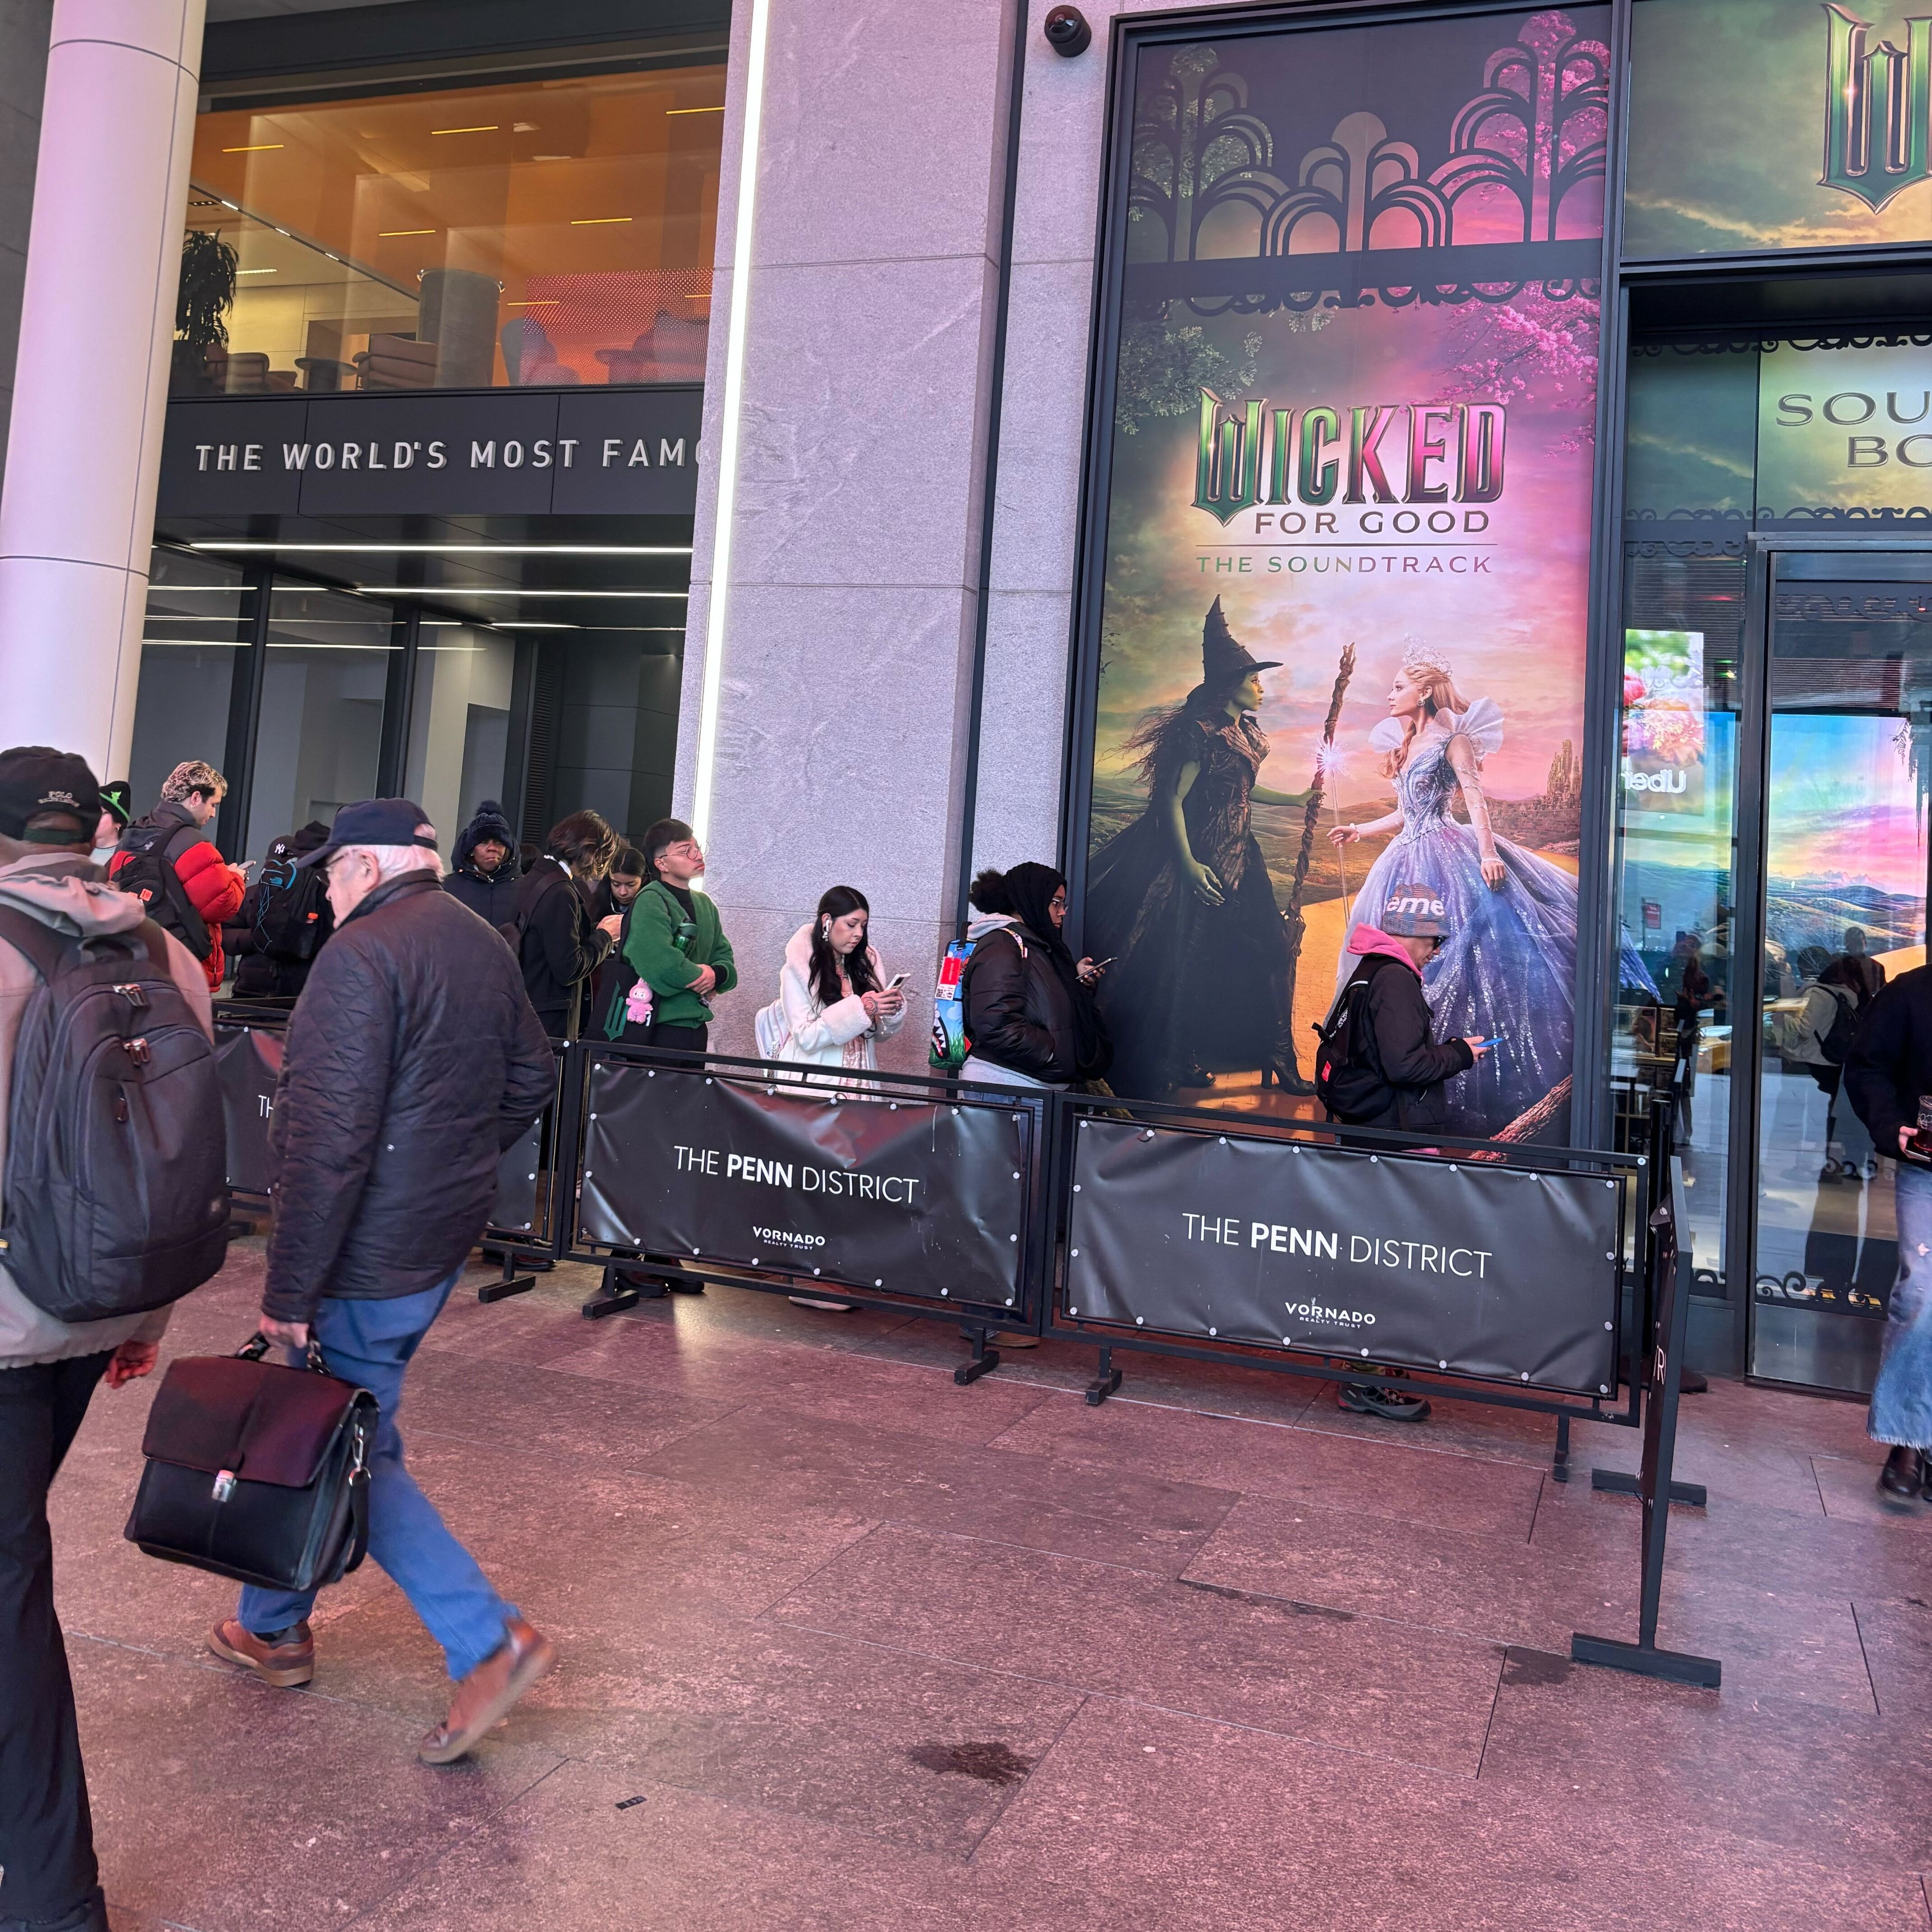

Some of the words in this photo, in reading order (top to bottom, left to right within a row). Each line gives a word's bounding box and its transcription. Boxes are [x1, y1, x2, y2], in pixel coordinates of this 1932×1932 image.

[195, 445, 263, 471] THE
[283, 441, 447, 470] WORLD'S
[470, 440, 580, 468] MOST
[1191, 386, 1507, 527] WICKED
[1255, 512, 1339, 534] FOR
[1359, 511, 1489, 534] GOOD
[1196, 557, 1252, 573] THE
[1267, 556, 1493, 573] SOUNDTRACK
[258, 1095, 274, 1118] TH
[674, 1145, 720, 1175] THE
[727, 1154, 793, 1188] PENN
[802, 1167, 920, 1204] DISTRICT
[753, 1226, 825, 1246] VORNADO
[1182, 1213, 1240, 1246] THE
[1251, 1222, 1338, 1259] PENN
[1351, 1235, 1492, 1278] DISTRICT
[1285, 1302, 1375, 1325] VORNADO
